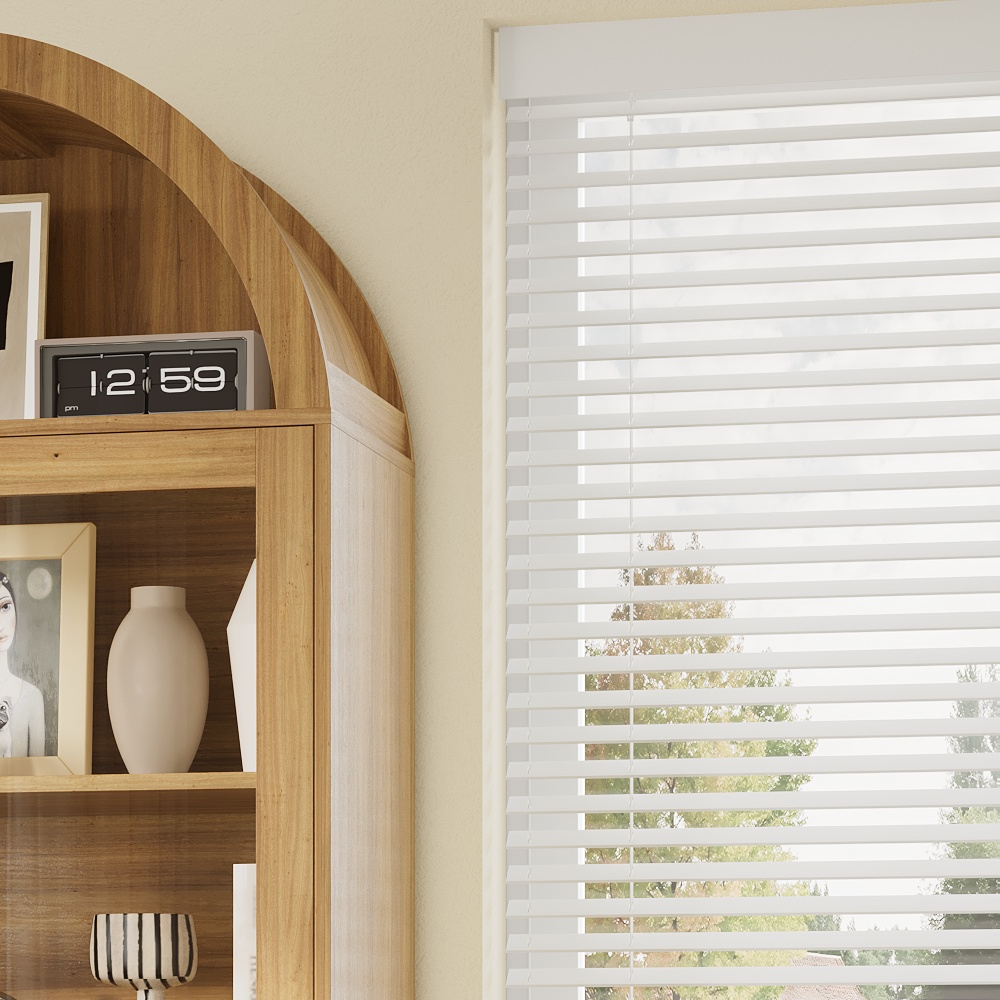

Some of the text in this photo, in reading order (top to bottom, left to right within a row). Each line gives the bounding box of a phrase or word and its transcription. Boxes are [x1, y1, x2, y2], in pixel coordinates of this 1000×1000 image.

[90, 366, 226, 397] 12 59
[64, 404, 79, 413] pm
